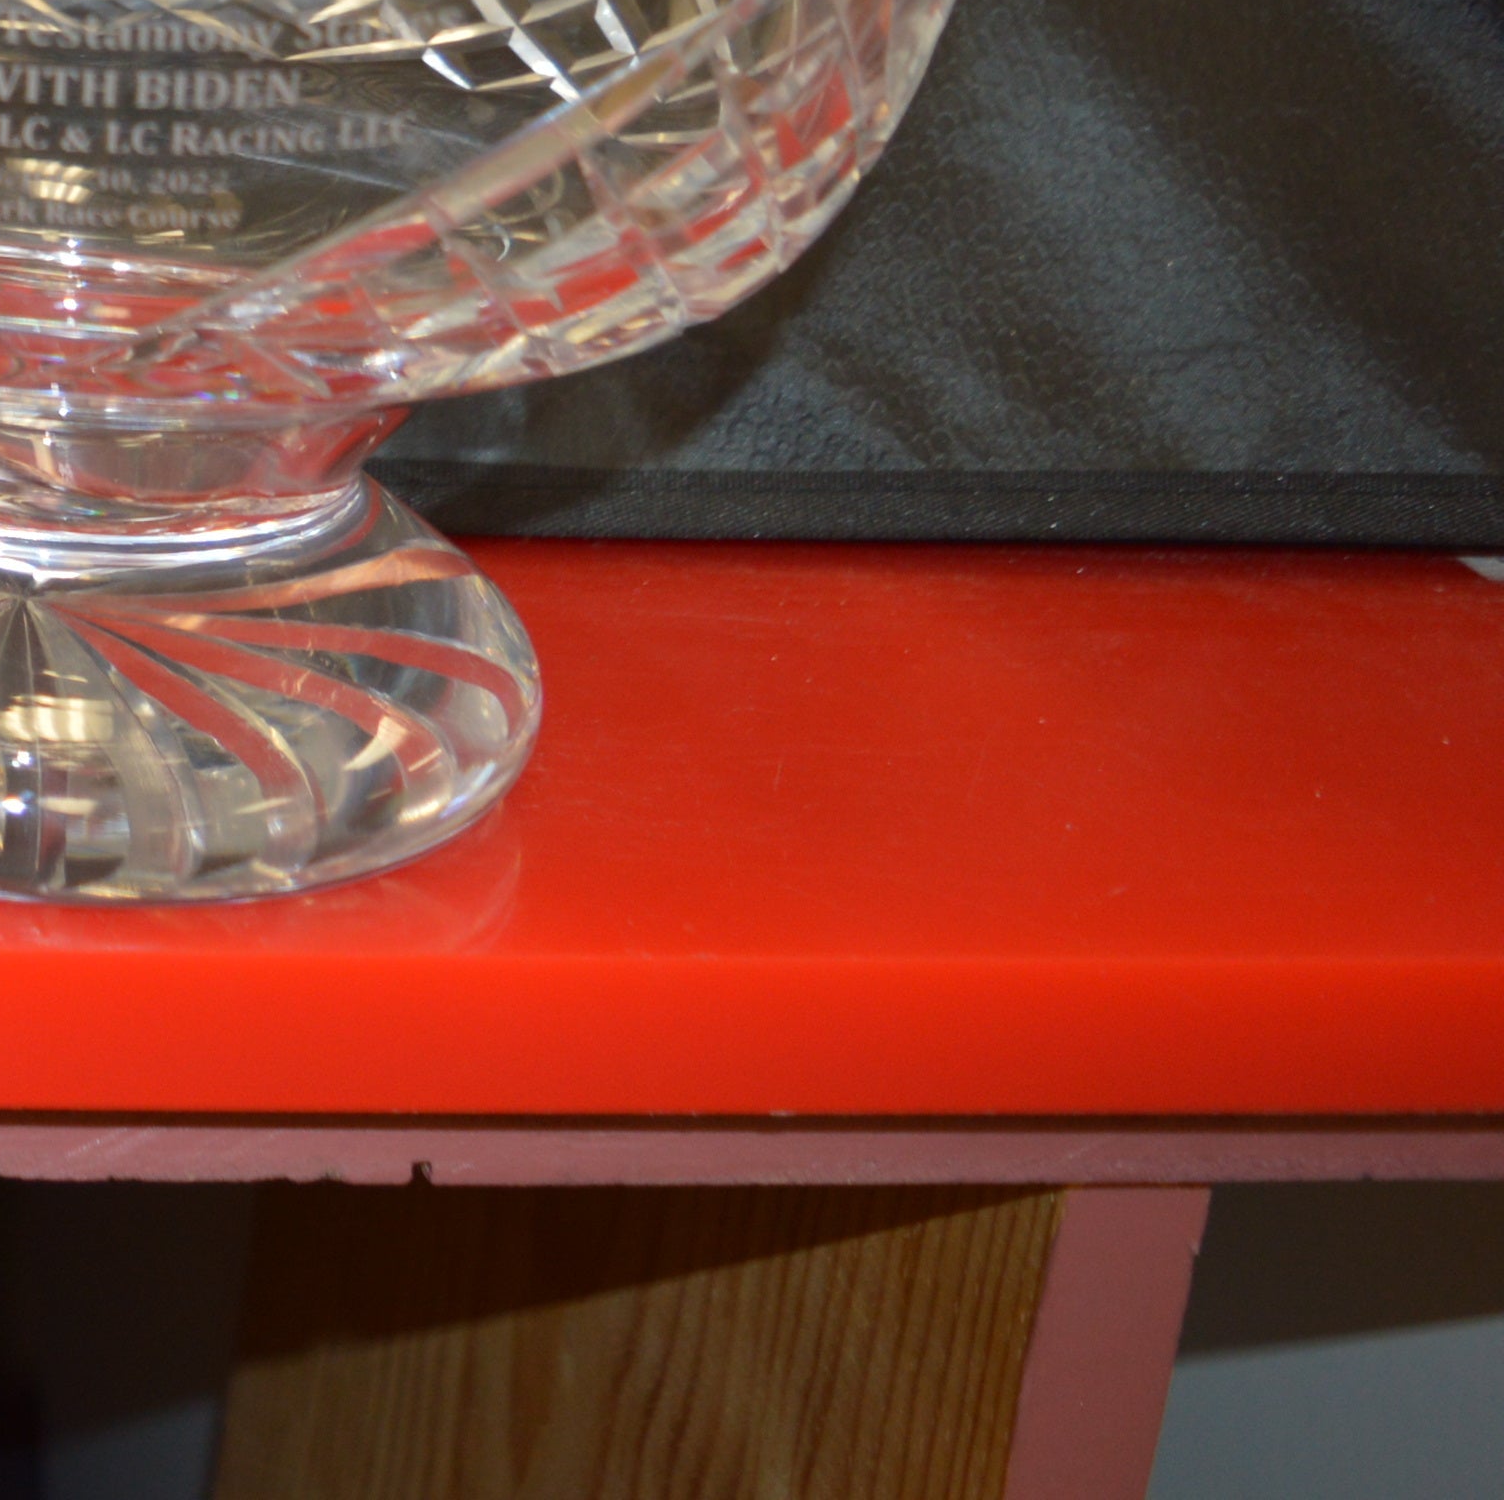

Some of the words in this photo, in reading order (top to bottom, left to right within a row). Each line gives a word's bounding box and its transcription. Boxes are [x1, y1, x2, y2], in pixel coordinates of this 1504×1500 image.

[2, 3, 283, 60] Testamony
[134, 68, 301, 112] BIDEN
[59, 124, 92, 154] &
[105, 121, 160, 156] LC
[337, 110, 417, 150] LLC
[44, 199, 122, 230] Race
[126, 202, 242, 231] Course
